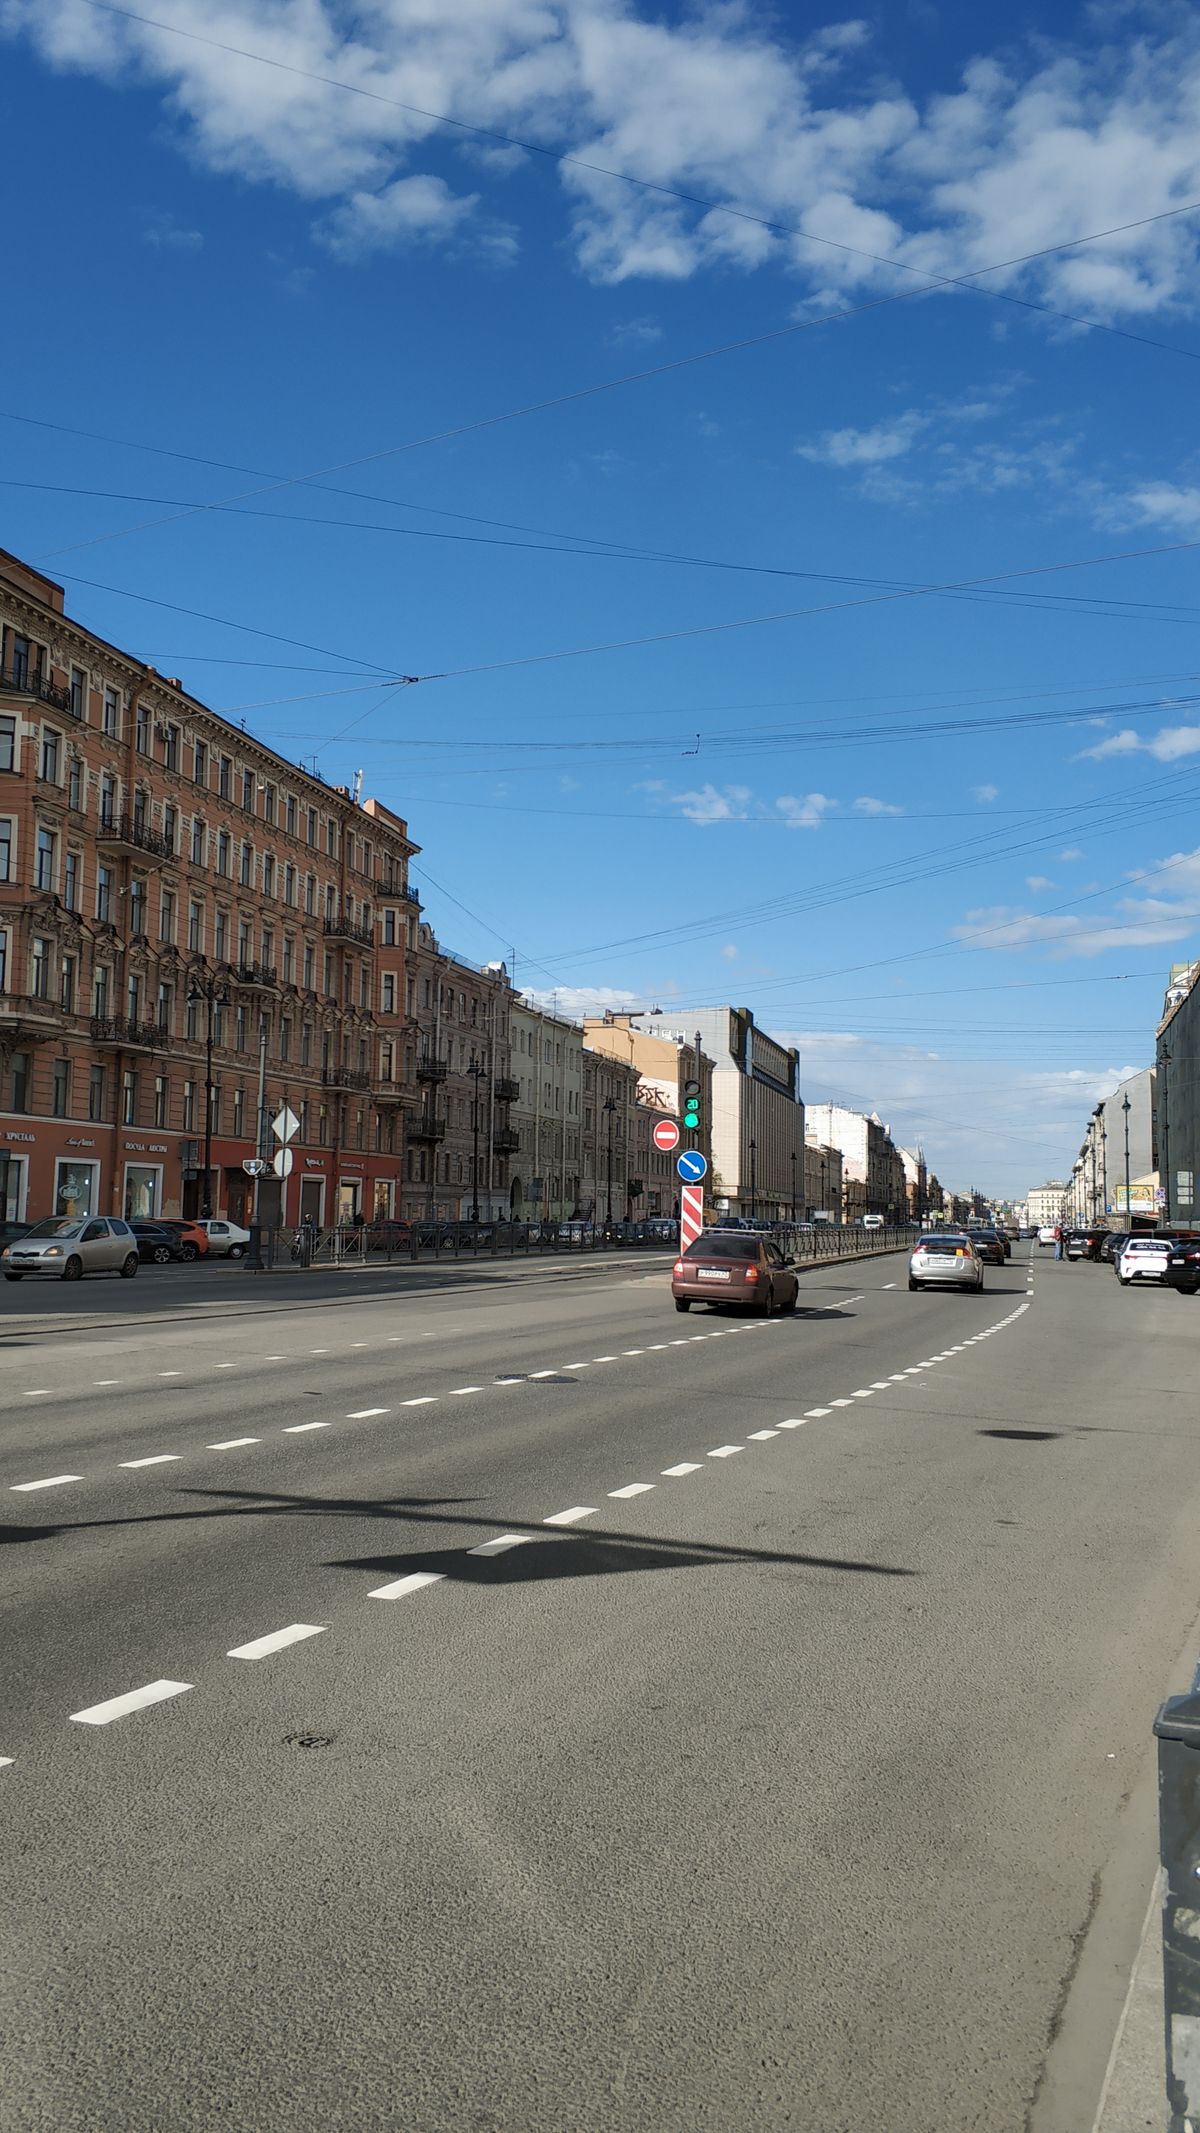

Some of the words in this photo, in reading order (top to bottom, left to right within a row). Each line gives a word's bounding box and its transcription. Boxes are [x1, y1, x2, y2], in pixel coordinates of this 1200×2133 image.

[687, 1099, 699, 1109] 20
[6, 1131, 36, 1142] ХРУСТАЛЬ
[125, 1141, 145, 1151] ПОСУДА
[148, 1144, 168, 1153] ЛЮСТРЫ
